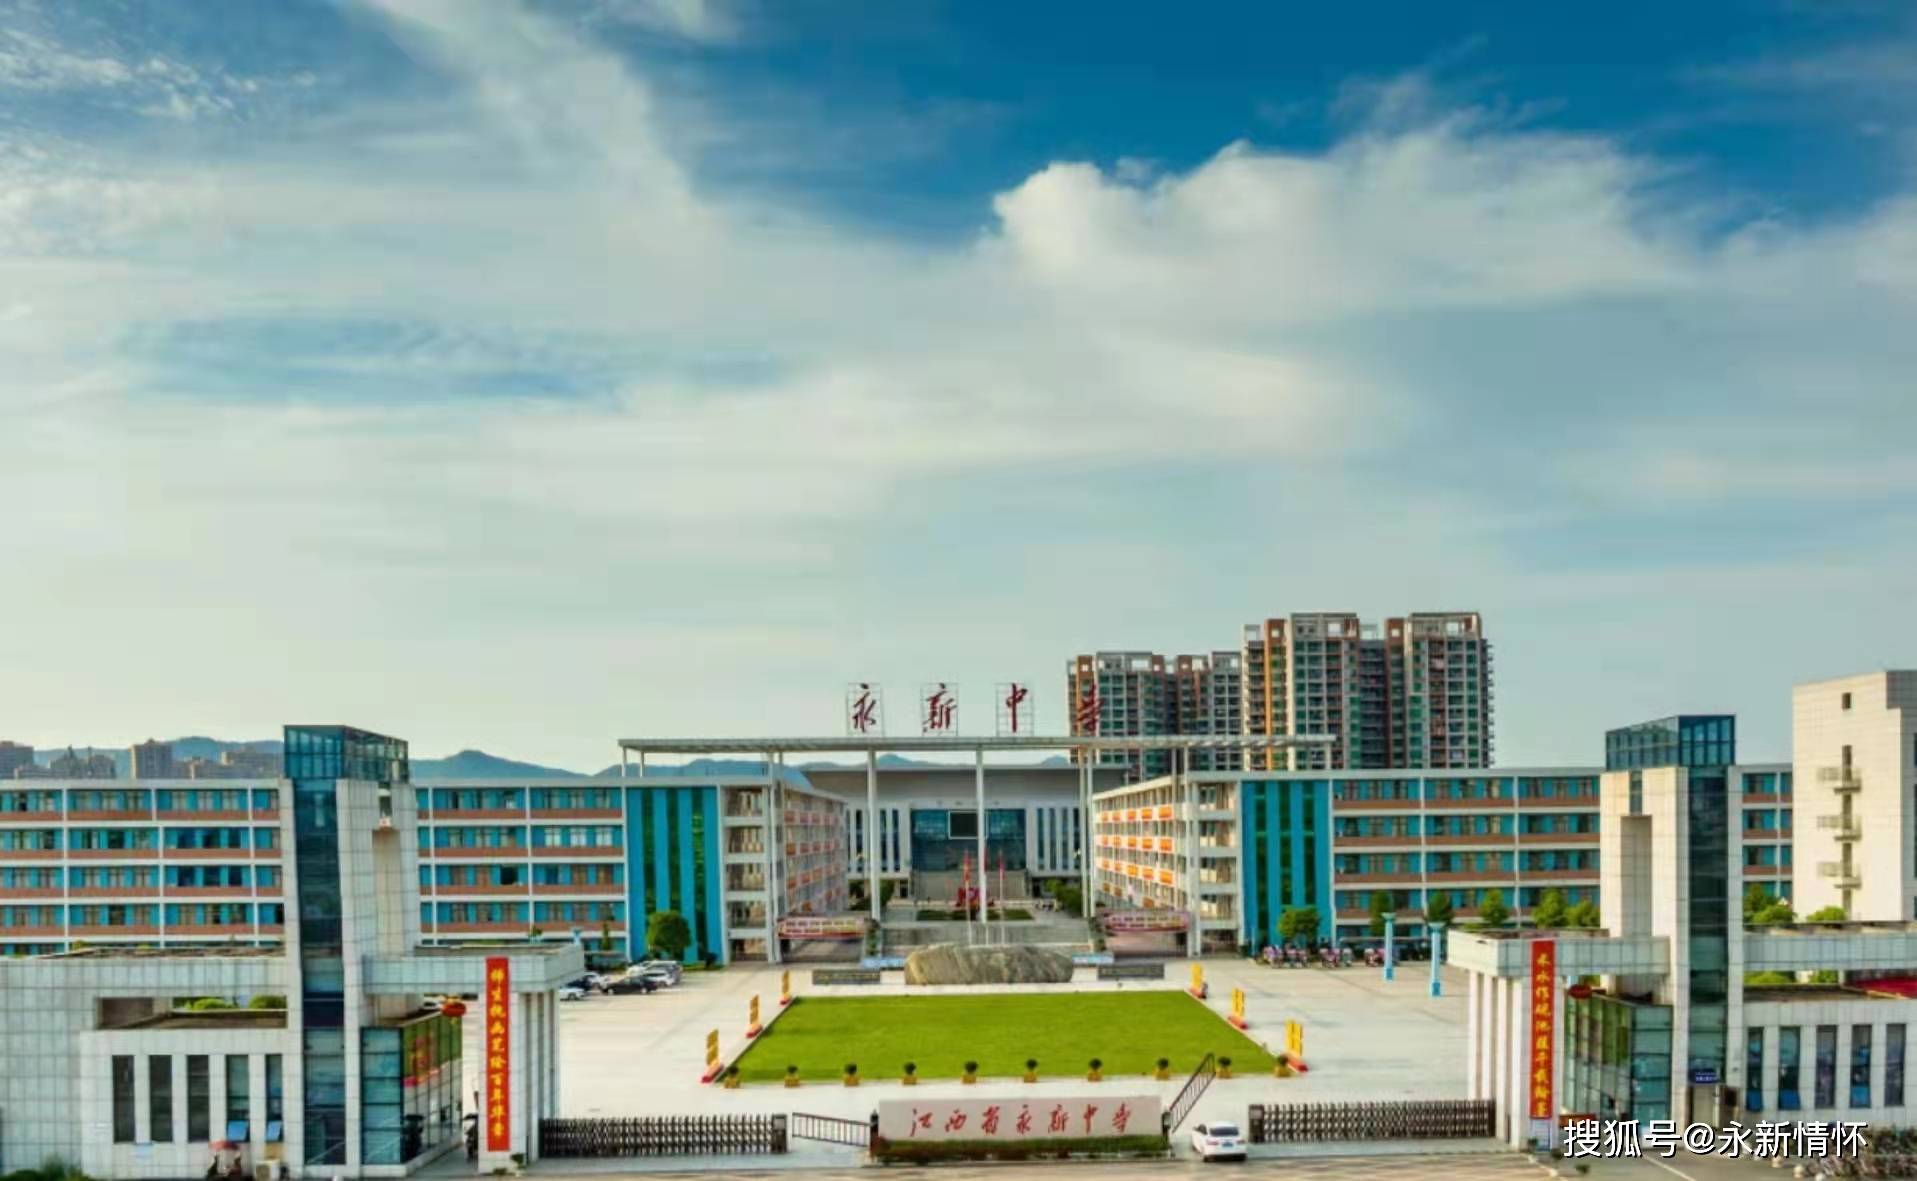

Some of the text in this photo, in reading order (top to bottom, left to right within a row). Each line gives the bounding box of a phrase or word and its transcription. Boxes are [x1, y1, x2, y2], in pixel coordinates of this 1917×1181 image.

[852, 682, 1105, 733] 永新中学
[910, 1104, 1132, 1137] 江西省永新中学
